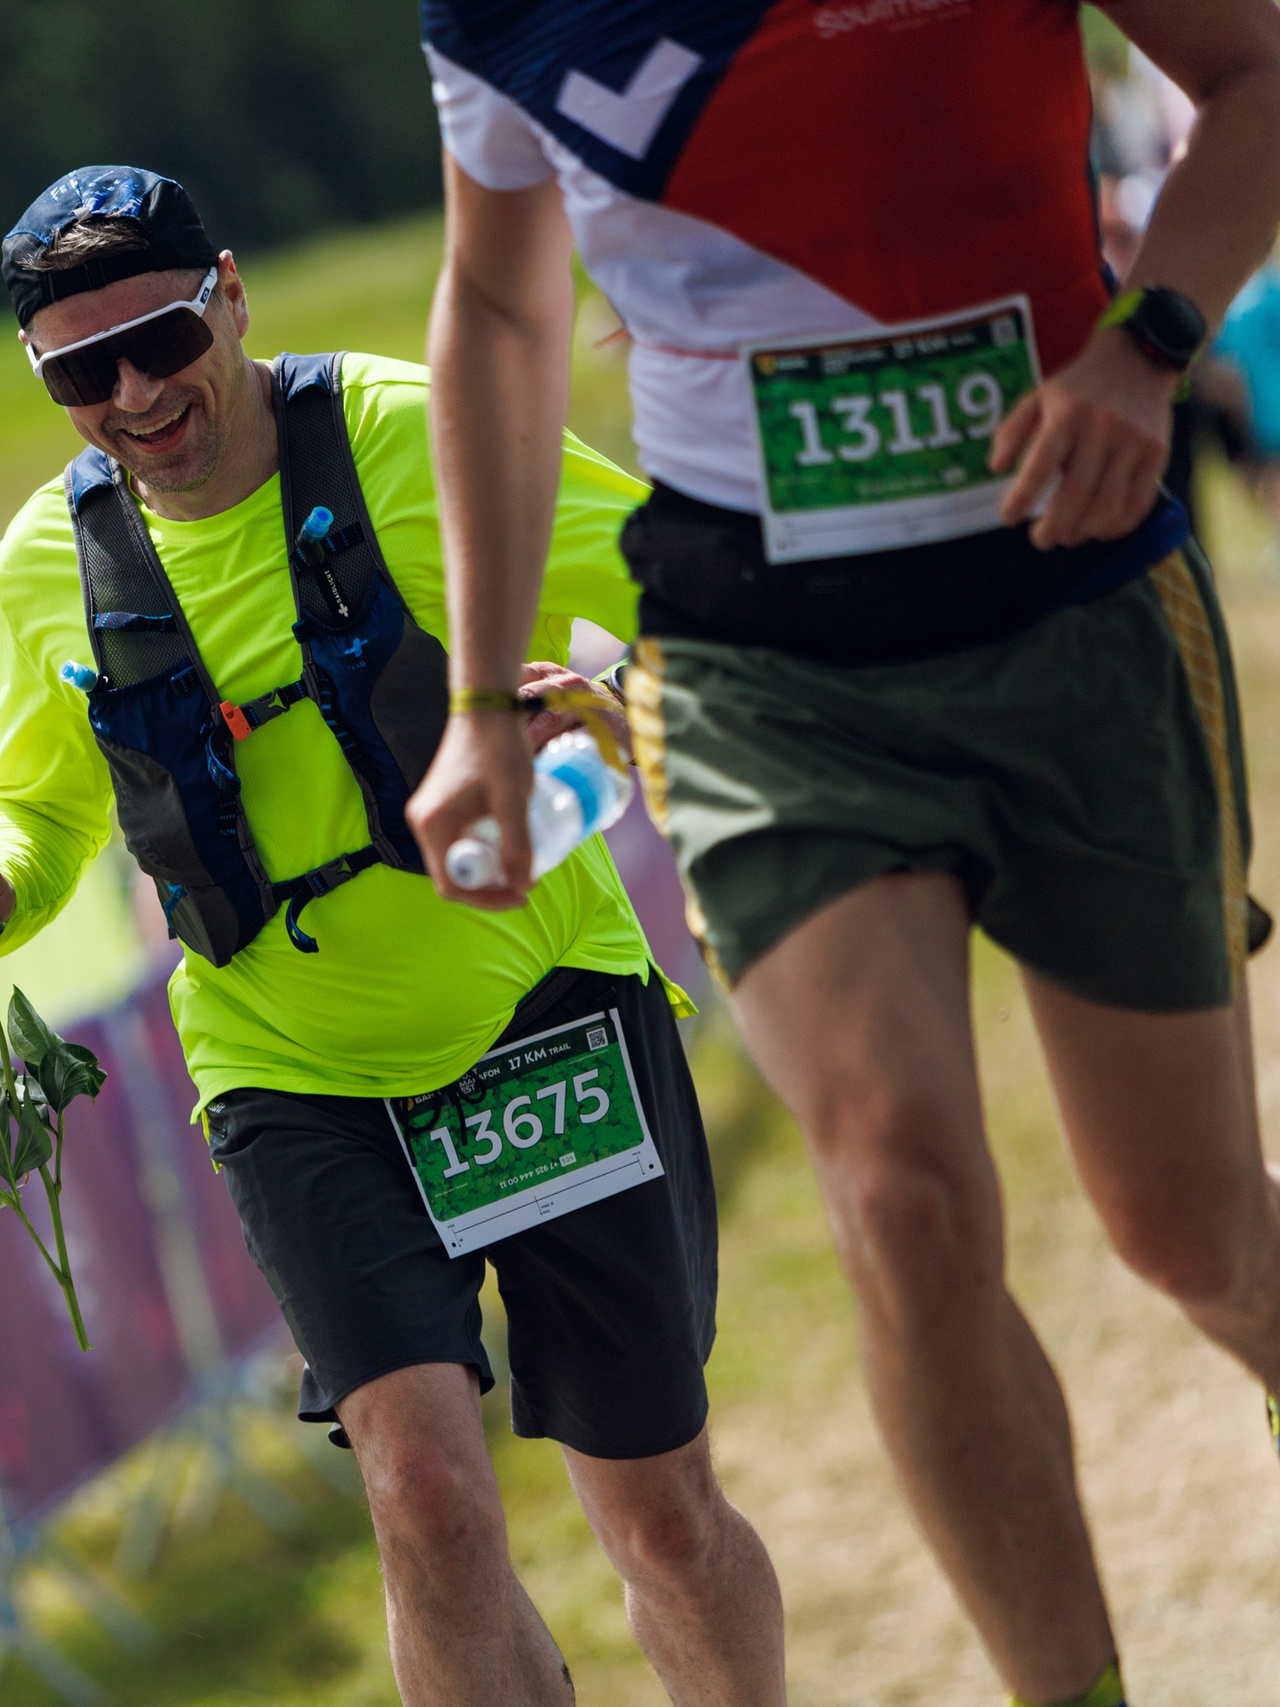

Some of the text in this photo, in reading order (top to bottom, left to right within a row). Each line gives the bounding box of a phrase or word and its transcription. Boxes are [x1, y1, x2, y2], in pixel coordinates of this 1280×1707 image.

[788, 371, 1003, 467] 13119
[324, 570, 342, 604] RAIDLIGHT
[508, 1043, 571, 1071] 17 KM TRAIL
[429, 1068, 610, 1179] 13675
[508, 1177, 519, 1186] 00
[520, 1170, 534, 1181] 444
[535, 1164, 549, 1175] 925
